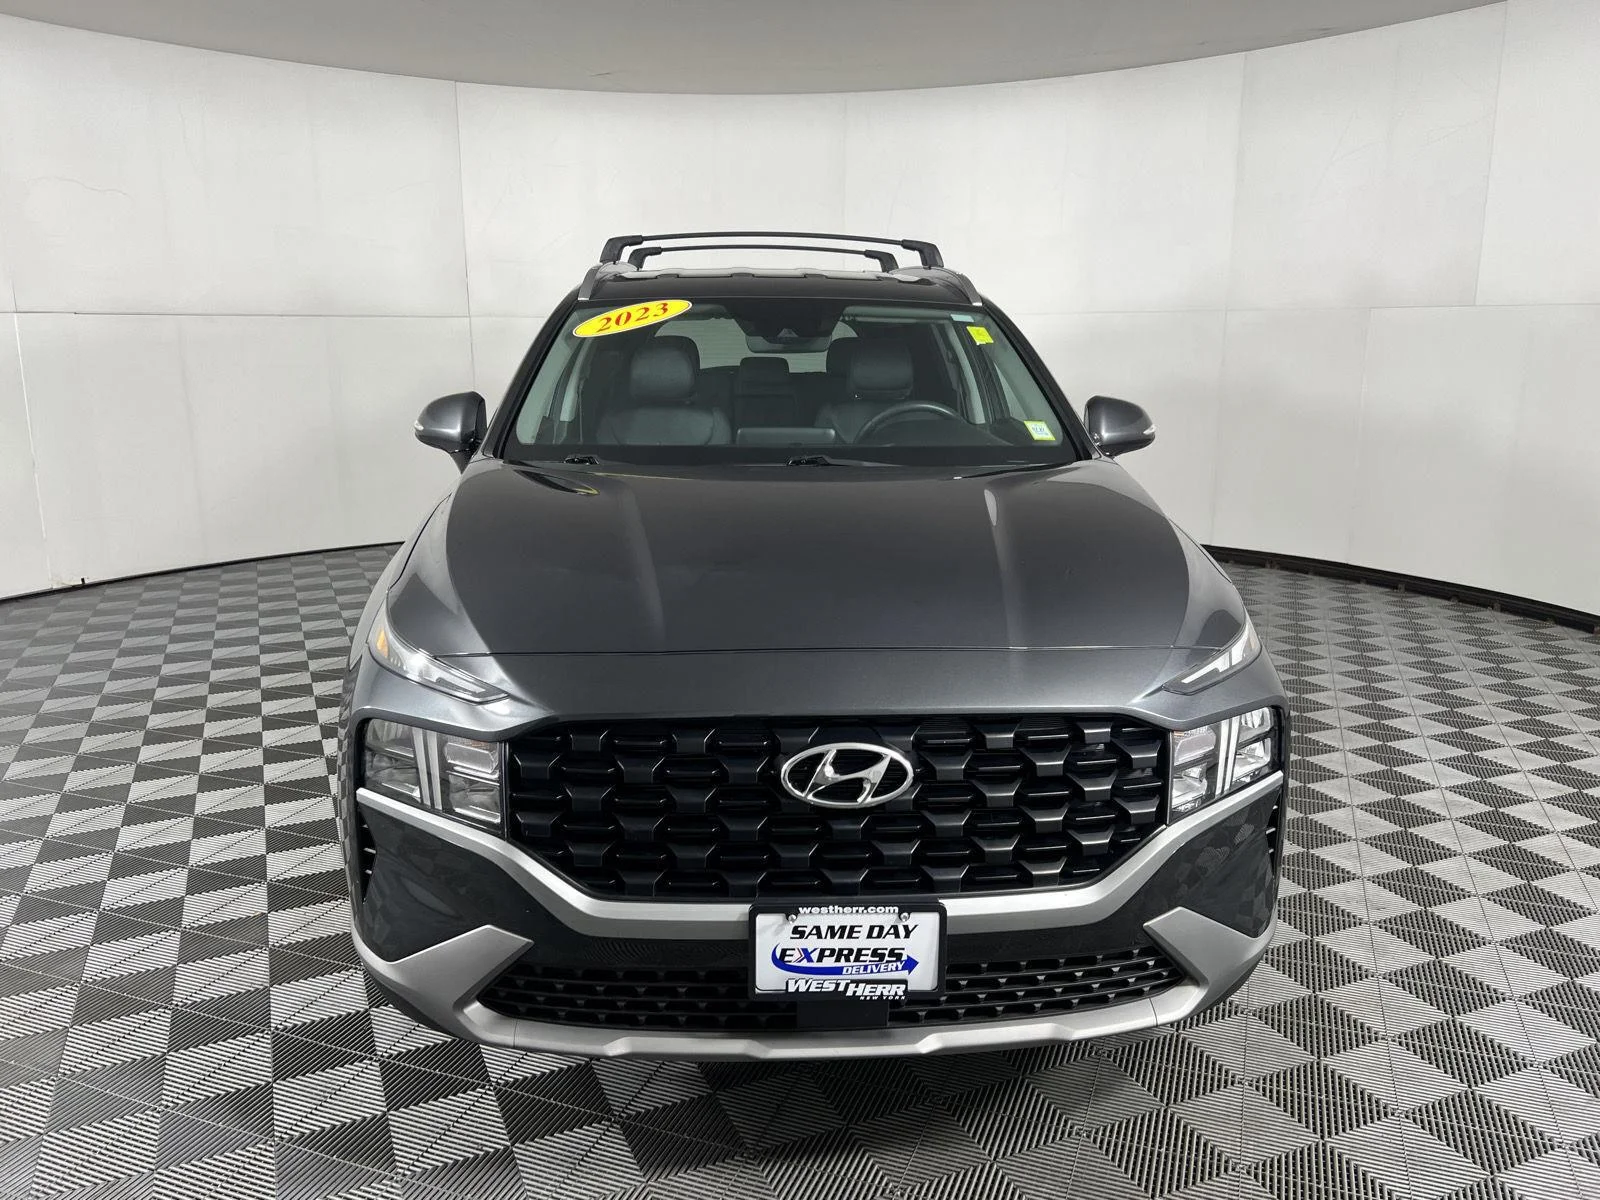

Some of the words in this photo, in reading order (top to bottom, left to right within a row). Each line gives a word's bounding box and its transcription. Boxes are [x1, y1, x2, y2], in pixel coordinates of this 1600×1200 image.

[597, 302, 669, 333] 2023
[799, 905, 899, 914] westherr.com
[790, 925, 862, 940] SAME
[866, 924, 919, 940] DAY
[780, 947, 906, 963] EXPRESS
[842, 962, 906, 976] DELIVERY
